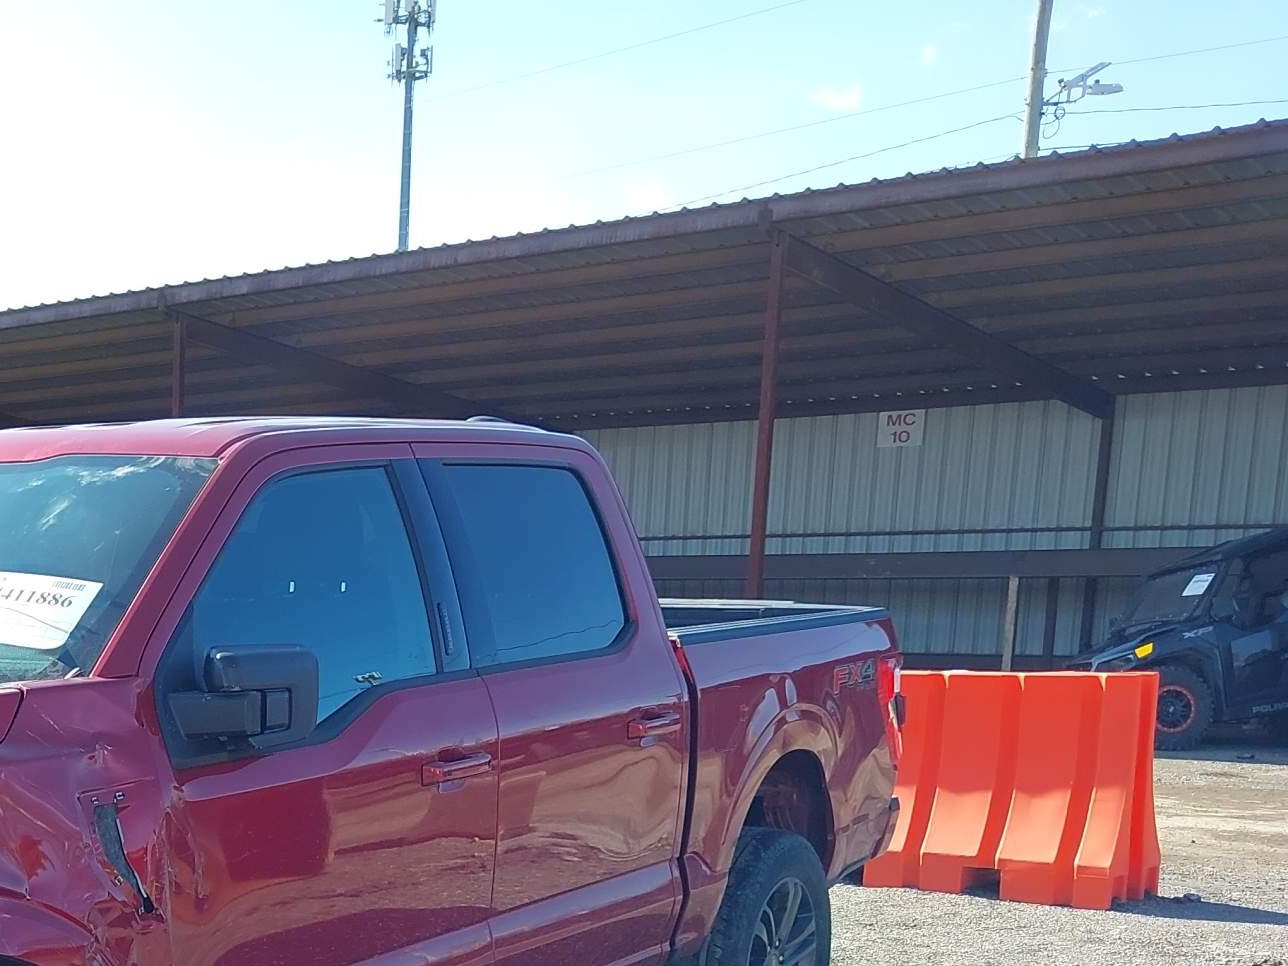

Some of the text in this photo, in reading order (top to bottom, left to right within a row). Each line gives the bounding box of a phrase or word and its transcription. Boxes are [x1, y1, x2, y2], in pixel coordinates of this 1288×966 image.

[886, 412, 917, 427] MC
[889, 430, 911, 444] 10
[833, 658, 875, 697] FX4
